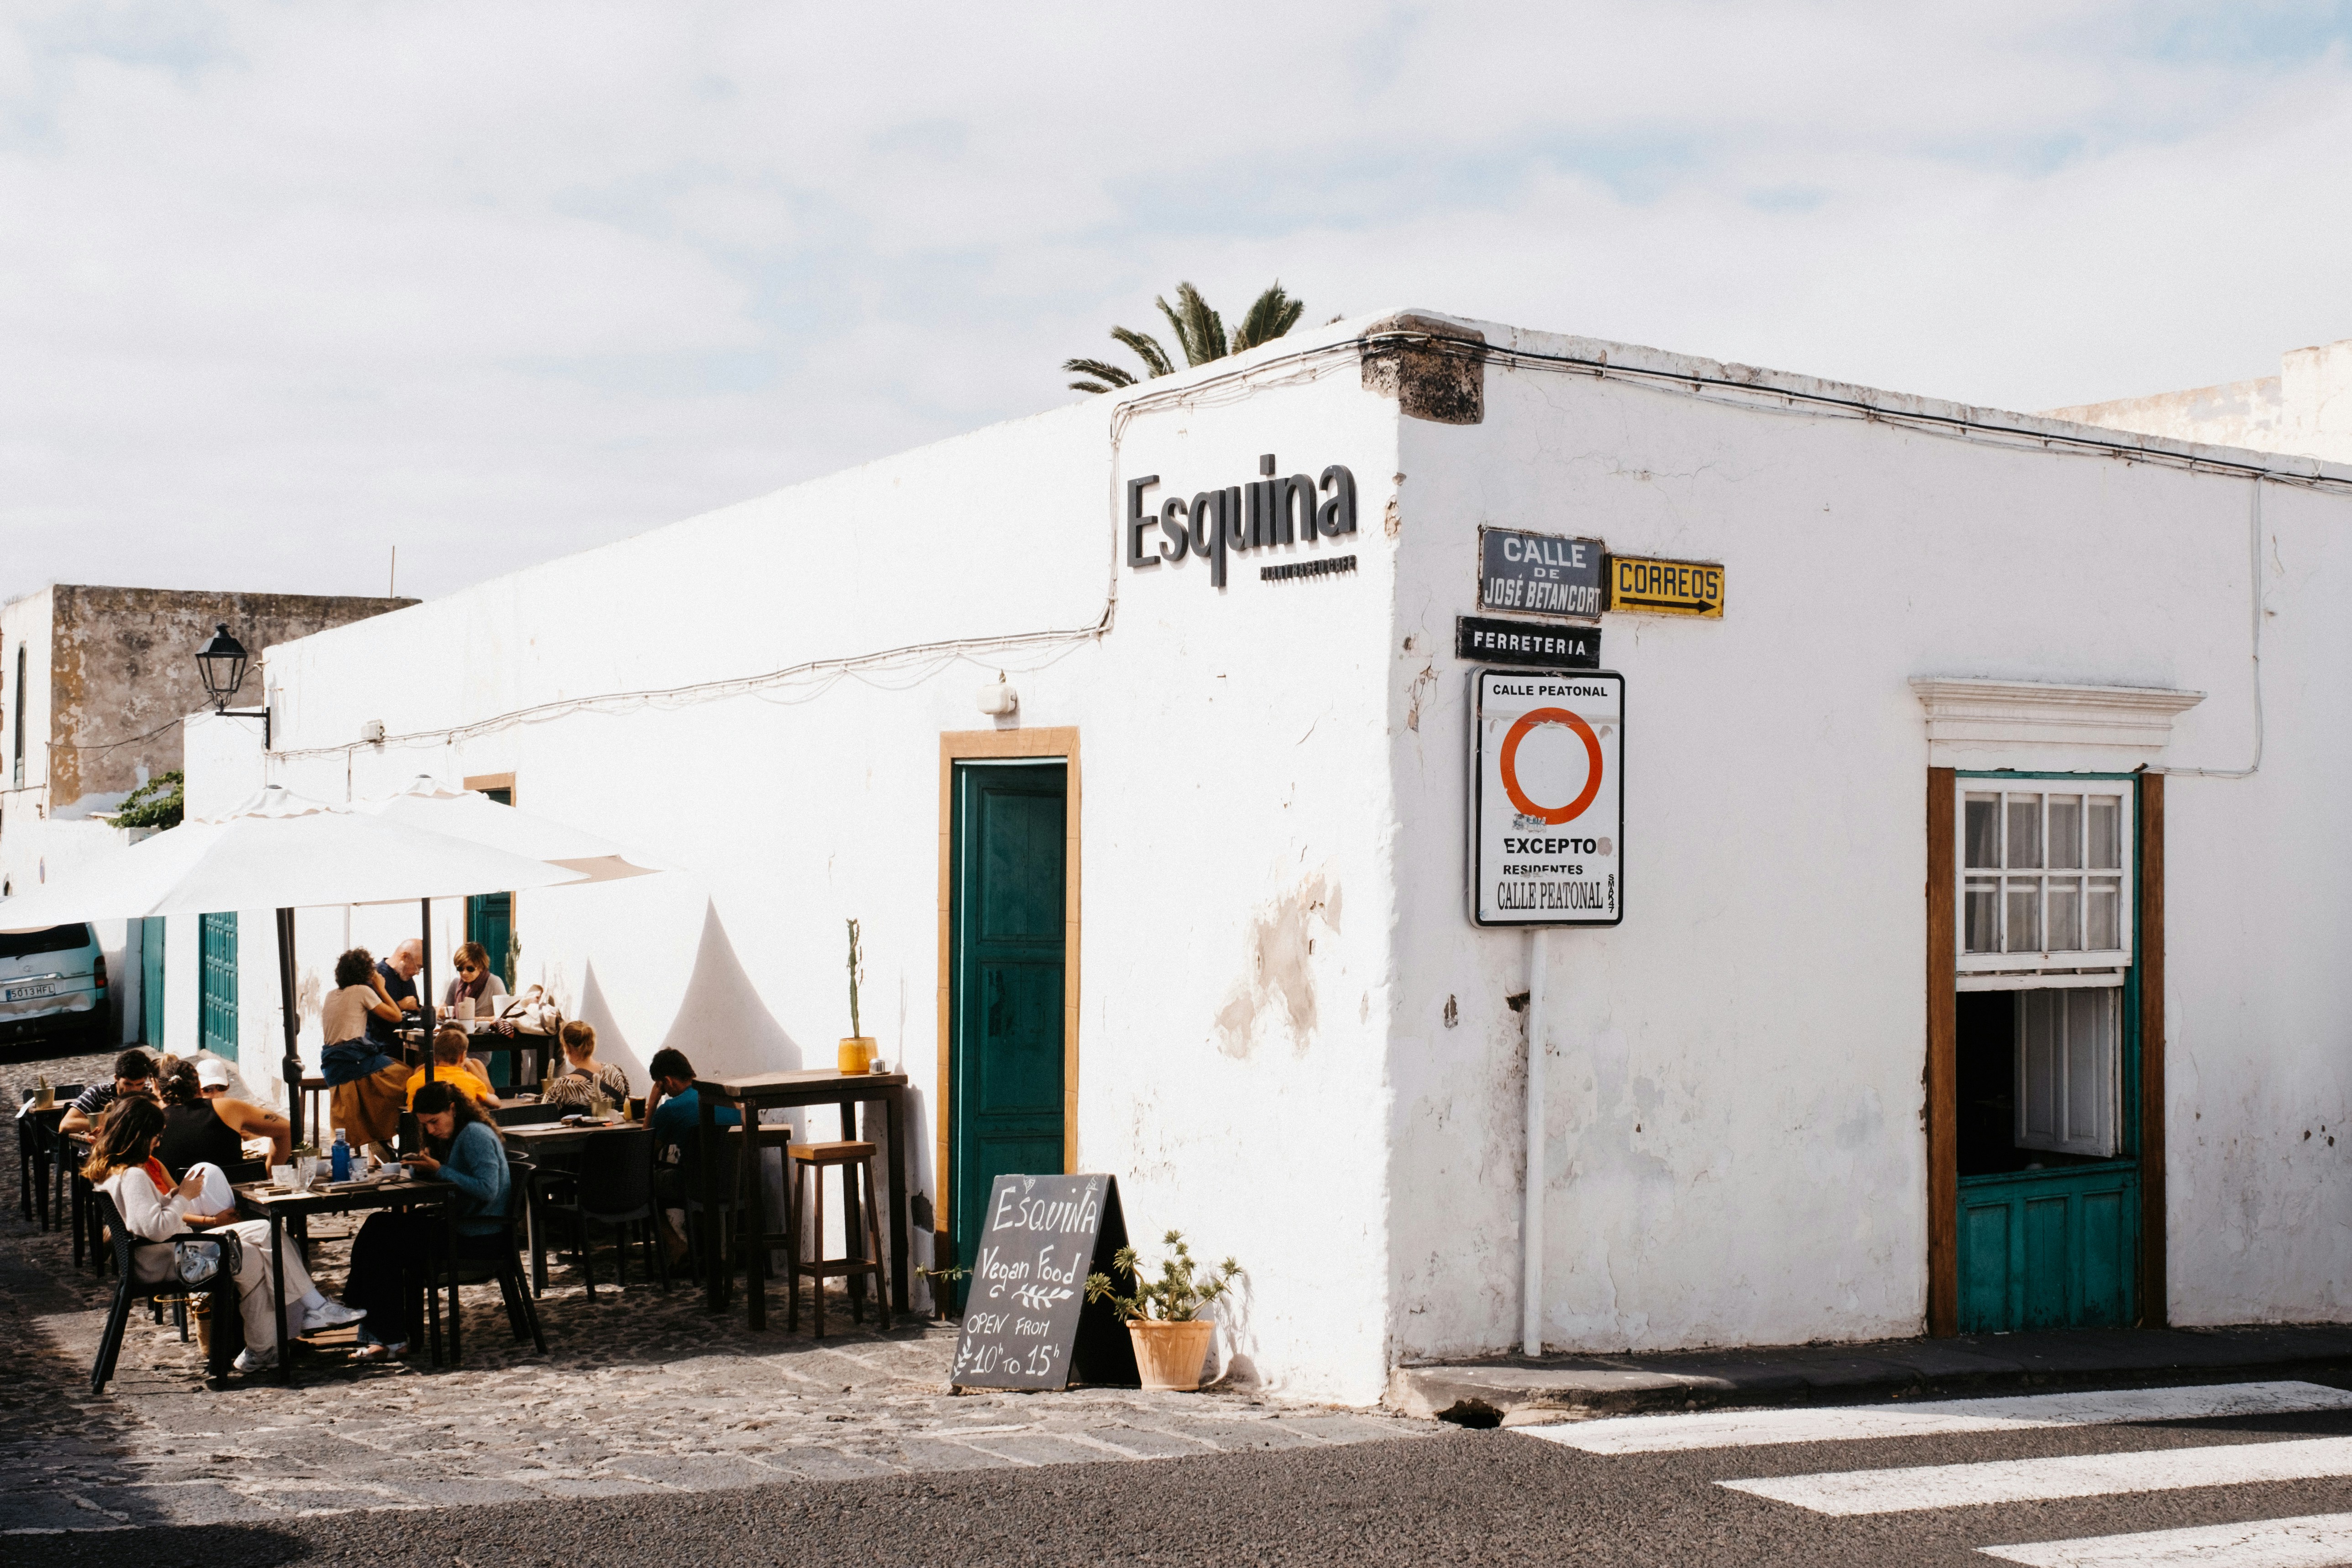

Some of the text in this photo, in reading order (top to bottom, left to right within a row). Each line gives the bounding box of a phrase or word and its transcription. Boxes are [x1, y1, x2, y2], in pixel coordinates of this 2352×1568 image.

[1127, 454, 1357, 587] Esquina
[1503, 538, 1587, 568] CALLE
[1260, 565, 1293, 581] PLANT
[1292, 559, 1328, 577] BASED
[1534, 567, 1560, 579] DE
[1619, 563, 1717, 599] CORREOS
[1484, 574, 1601, 614] JOSÉ BETANCORT
[1474, 631, 1586, 656] FERRETERIA
[1493, 684, 1608, 697] CALLE PEATONAL
[1503, 838, 1597, 854] EXCEPTO
[1503, 865, 1583, 875] RESIDENTES
[1498, 881, 1603, 910] CALLE PEATONAL
[982, 1244, 1082, 1298] Vegan Food
[967, 1312, 1050, 1337] OPEN FROM
[1002, 1357, 1021, 1374] TO
